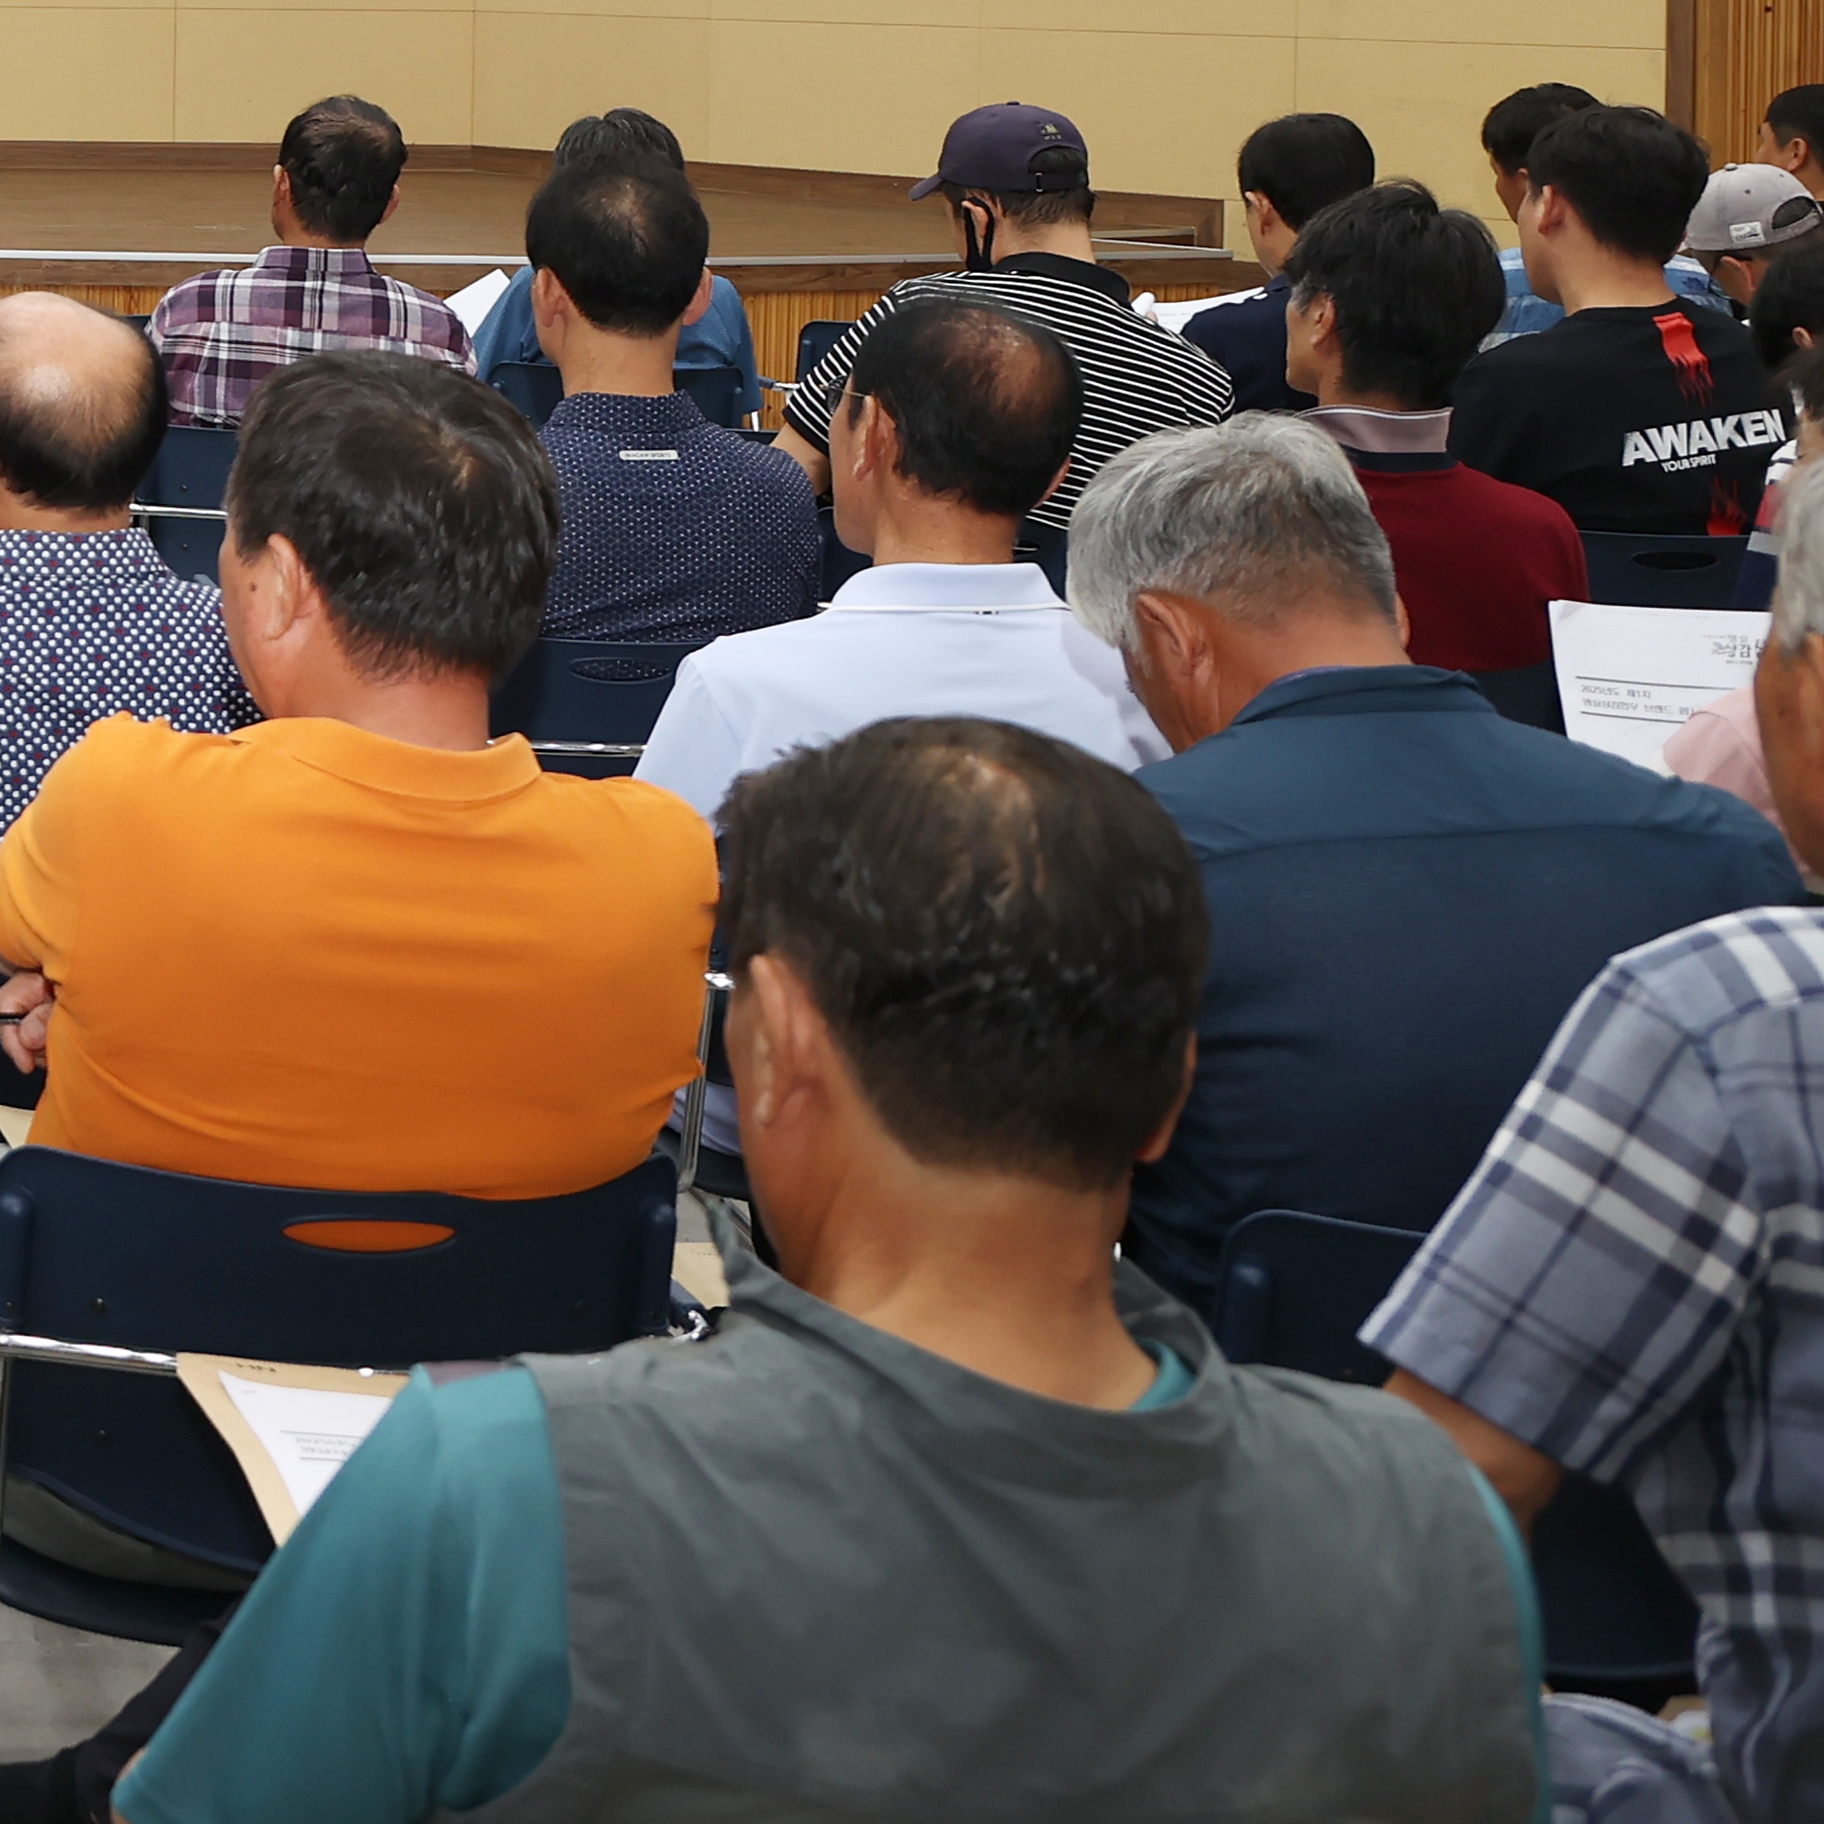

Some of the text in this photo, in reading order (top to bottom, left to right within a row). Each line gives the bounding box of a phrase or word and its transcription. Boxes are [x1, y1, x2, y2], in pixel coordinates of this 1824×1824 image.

[1621, 408, 1787, 467] AWAKEN
[1661, 453, 1717, 473] YOUR SPIRIT
